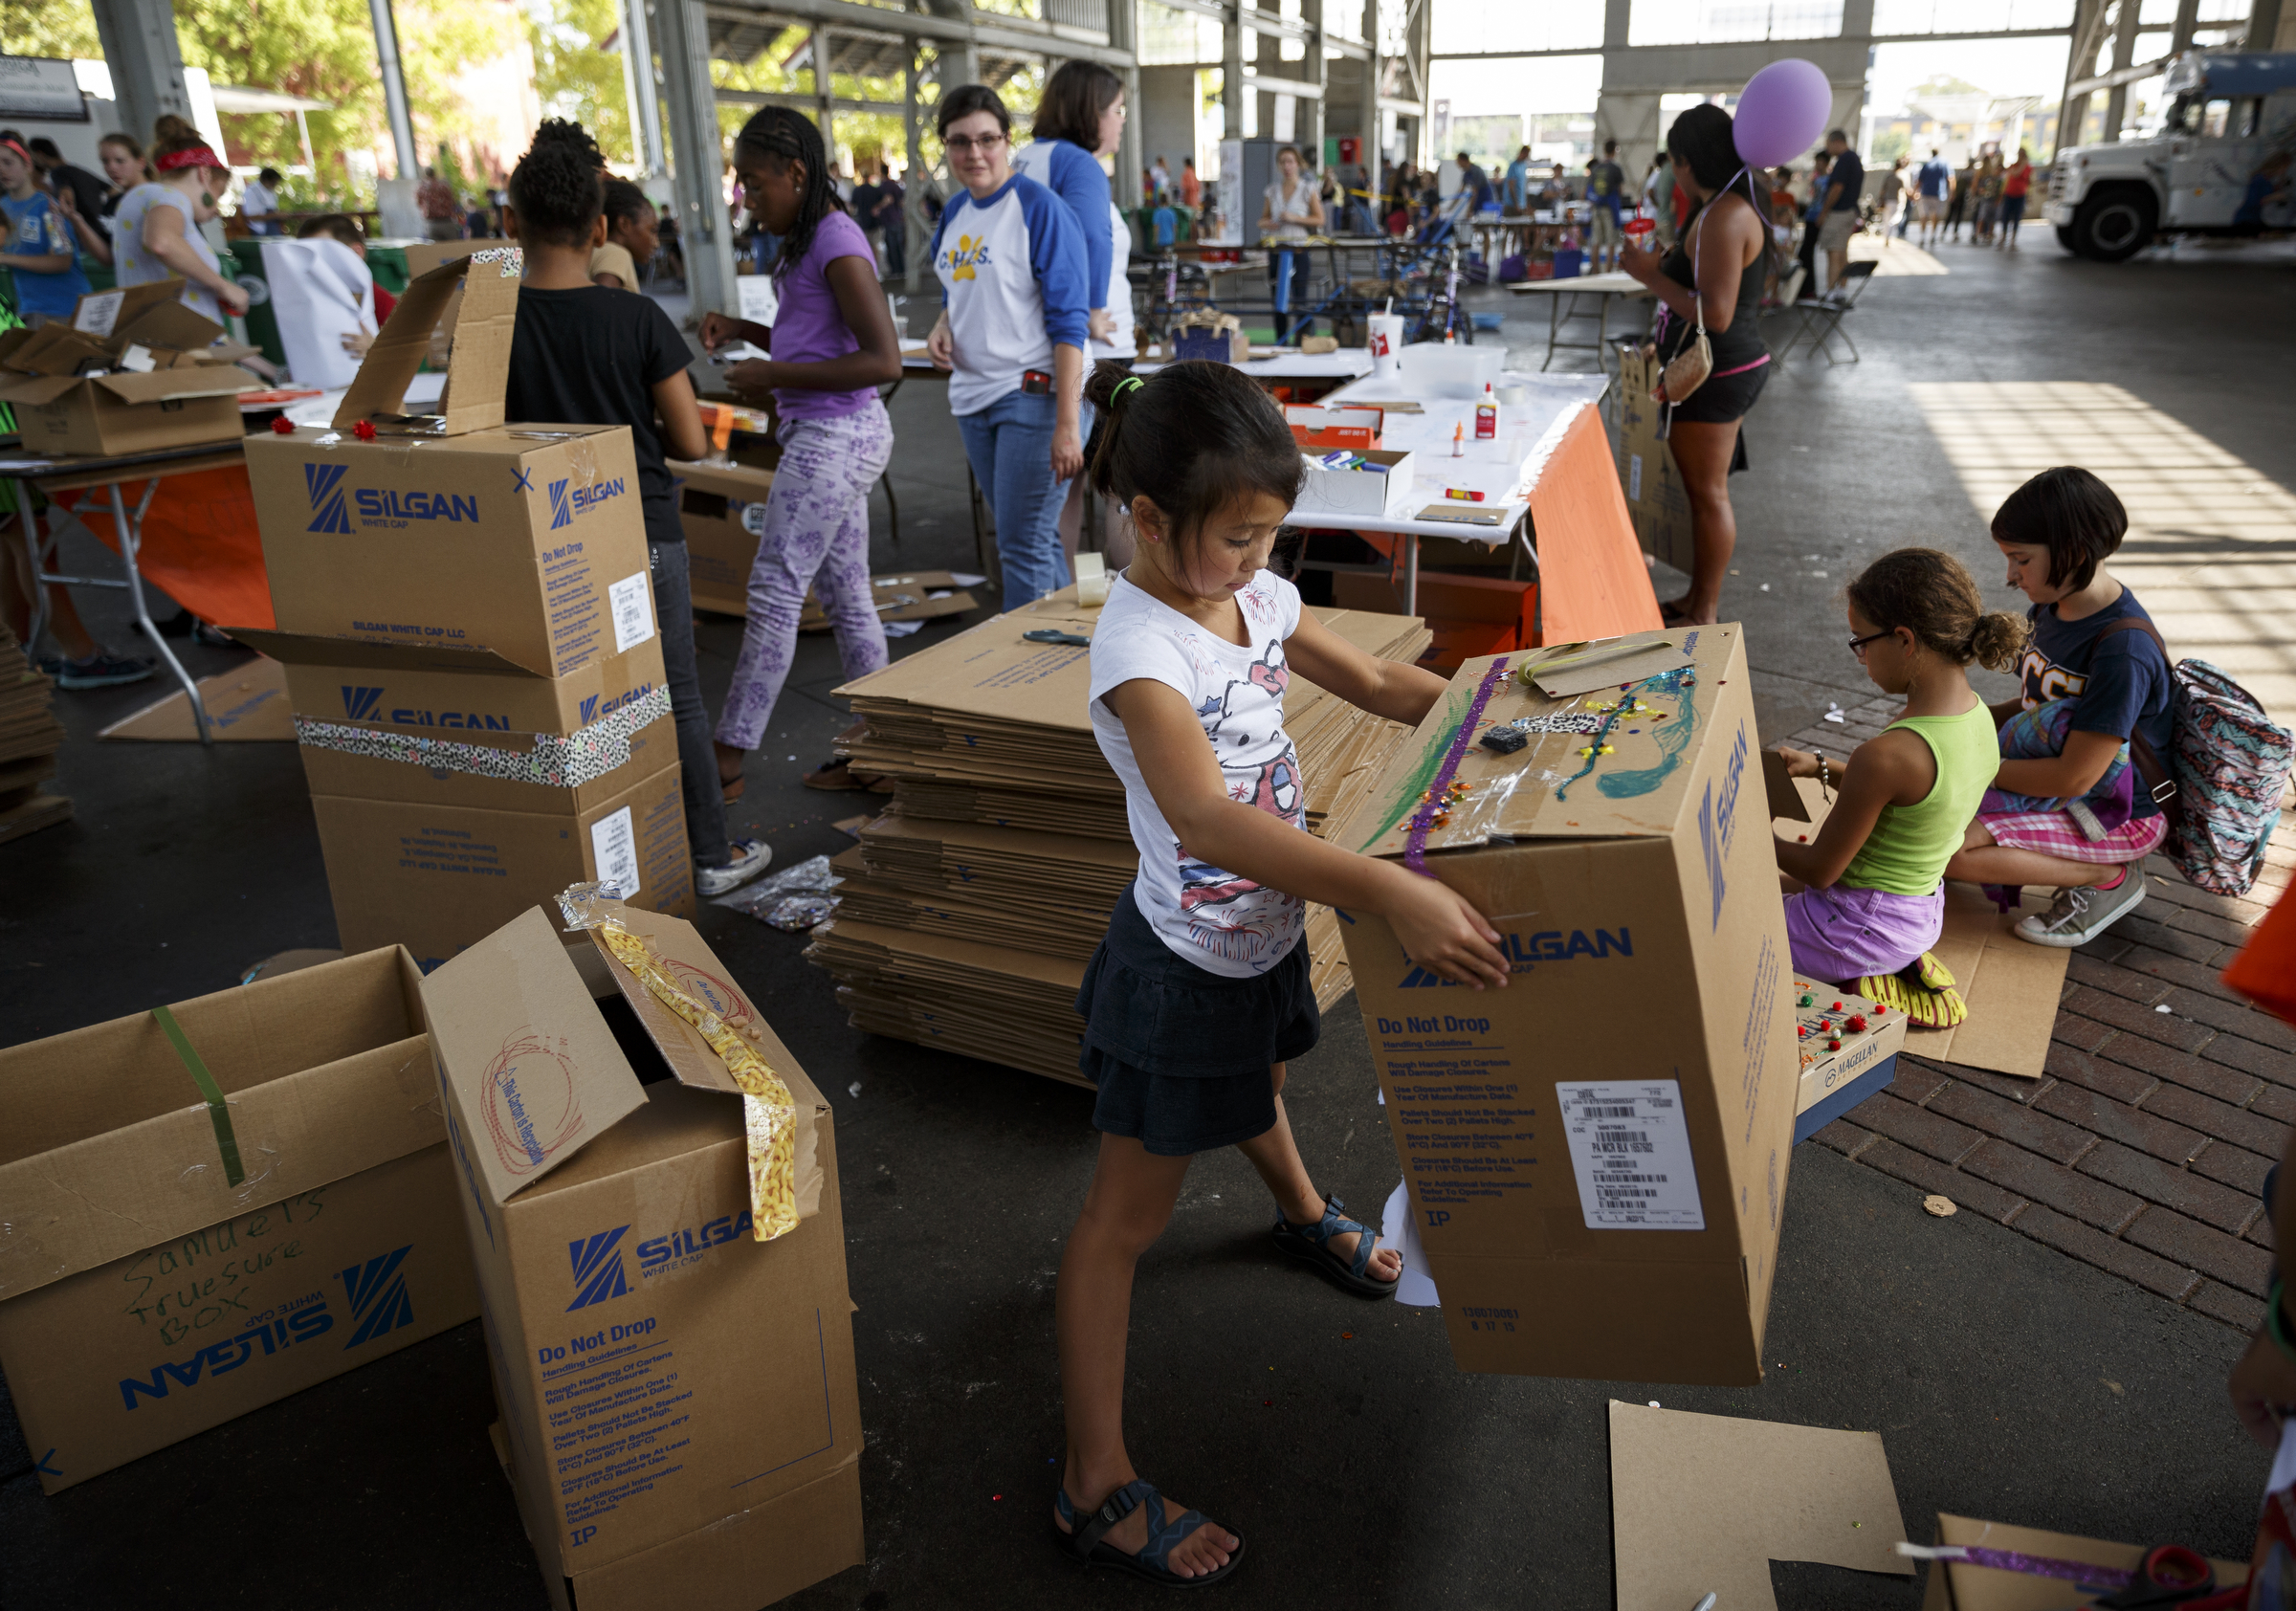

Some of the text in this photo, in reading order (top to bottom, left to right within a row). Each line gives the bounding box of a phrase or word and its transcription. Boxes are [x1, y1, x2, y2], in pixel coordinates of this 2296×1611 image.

[361, 518, 408, 529] WHITE CAP
[542, 541, 583, 563] Do Not Drop
[353, 621, 465, 639] SILGAN WHITE CAP LLC
[1511, 964, 1534, 974] CAP
[1377, 1015, 1490, 1034] Do Not Drop
[1387, 1061, 1417, 1069] Rough
[1838, 1040, 1878, 1077] MAGELLAN
[501, 1078, 545, 1166] This Carton is Recyclable
[1591, 1142, 1601, 1153] PA
[1425, 1210, 1450, 1226] IP
[636, 1210, 753, 1269] SILGA
[642, 1253, 704, 1279] WHITE CAP
[245, 1291, 324, 1327] WHITE CAP
[1485, 1321, 1496, 1331] 17
[538, 1317, 656, 1365] Do Not Drop
[542, 1344, 637, 1378] Handling Guidelines
[544, 1351, 673, 1398] Rough Handling Of Cartons
[545, 1367, 652, 1405] Will Damage Closures.
[549, 1411, 568, 1421] Use
[570, 1396, 613, 1414] Closures
[614, 1386, 644, 1399] Within
[645, 1378, 665, 1389] One
[550, 1382, 674, 1428] Year Of Manufacture Date.
[553, 1390, 693, 1444] Pallets Should Not Be Stacked
[554, 1439, 577, 1451] Over
[579, 1432, 600, 1442] Two
[615, 1416, 647, 1430] Pallets
[648, 1407, 673, 1419] High.
[557, 1454, 583, 1466] Store
[585, 1439, 627, 1456] Closures
[628, 1424, 669, 1442] Between
[561, 1438, 691, 1488] Closures Should Be At Least
[584, 1453, 603, 1465] And
[615, 1462, 646, 1477] Before
[648, 1455, 668, 1465] Use.
[565, 1464, 683, 1510] For Additional Information
[566, 1483, 654, 1518] Refer To Operating
[567, 1503, 619, 1525] Guidelines.
[570, 1525, 597, 1548] IP
